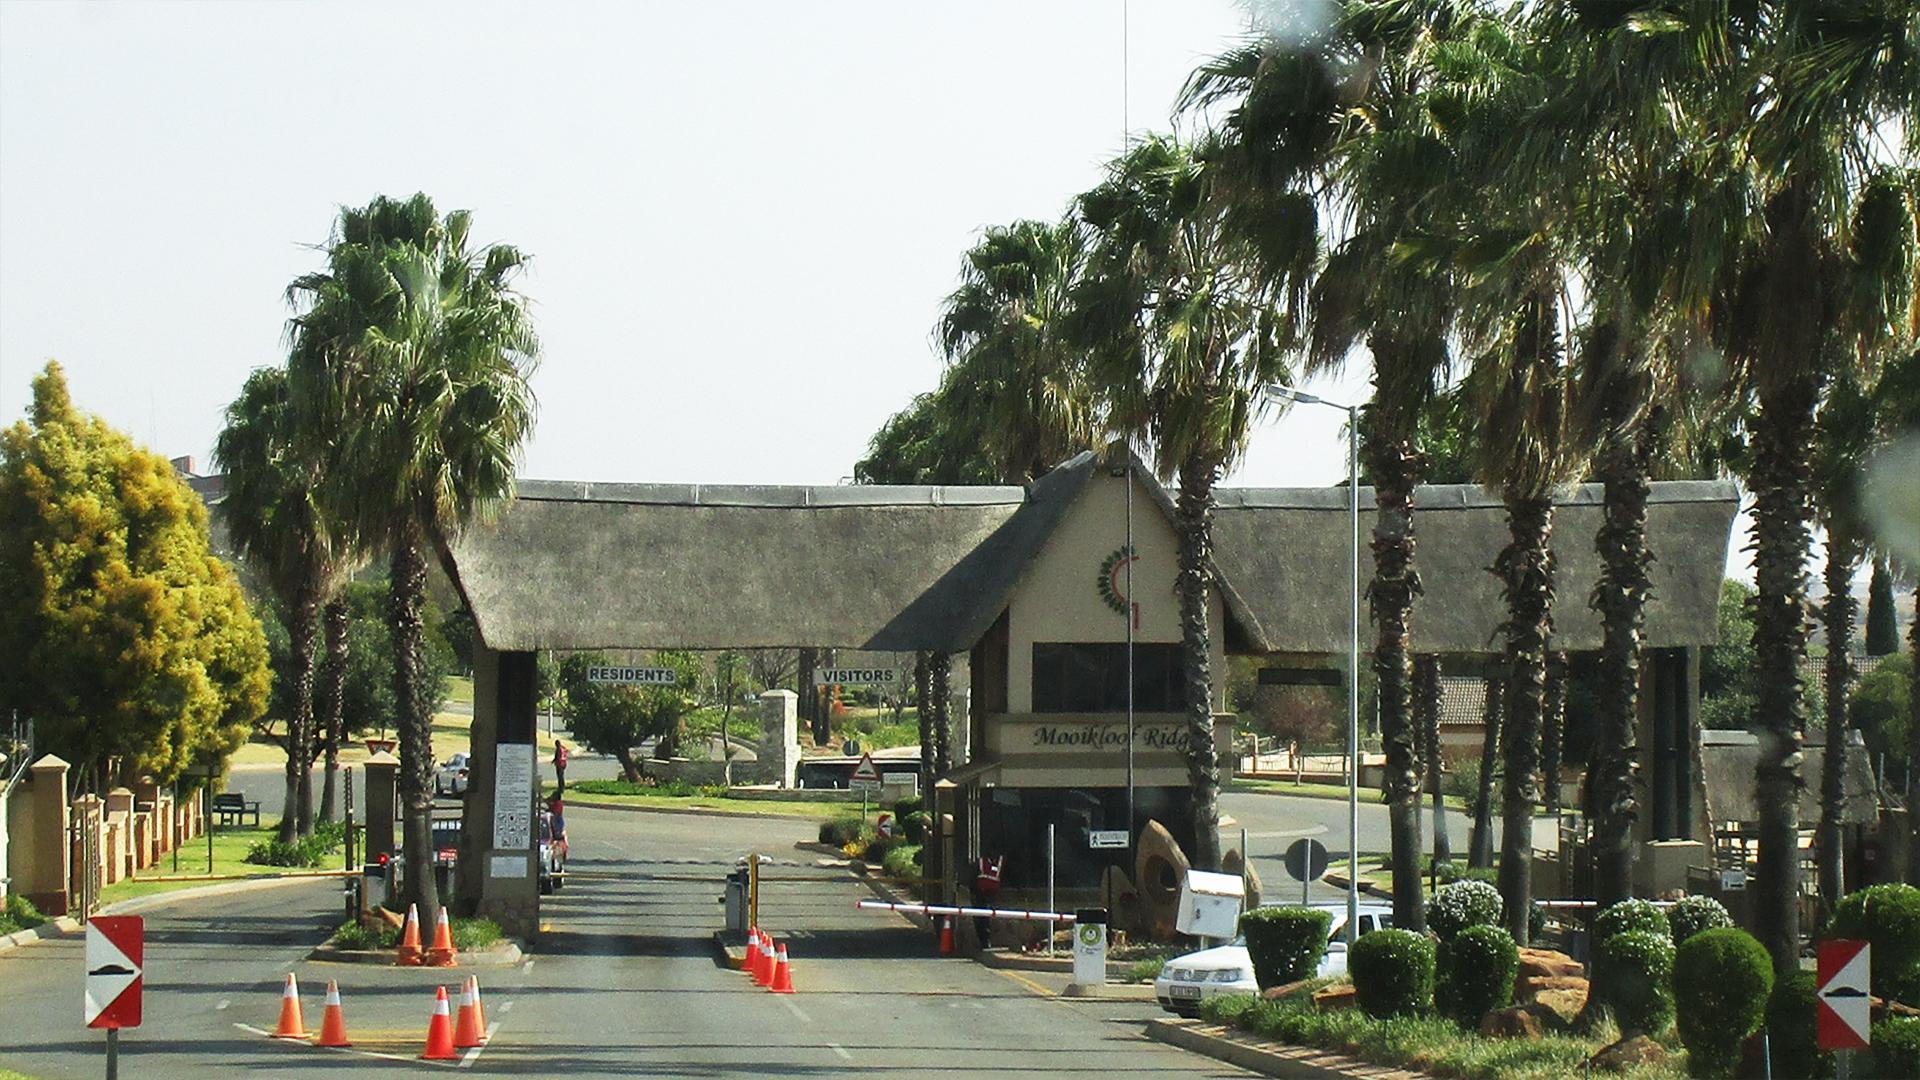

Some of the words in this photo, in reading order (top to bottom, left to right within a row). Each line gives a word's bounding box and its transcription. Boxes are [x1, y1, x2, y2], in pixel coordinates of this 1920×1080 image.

[589, 668, 675, 682] RESIDENTS
[823, 670, 894, 682] VISITORS
[1033, 725, 1142, 751] Mooikloof
[1143, 724, 1190, 752] Ridg
